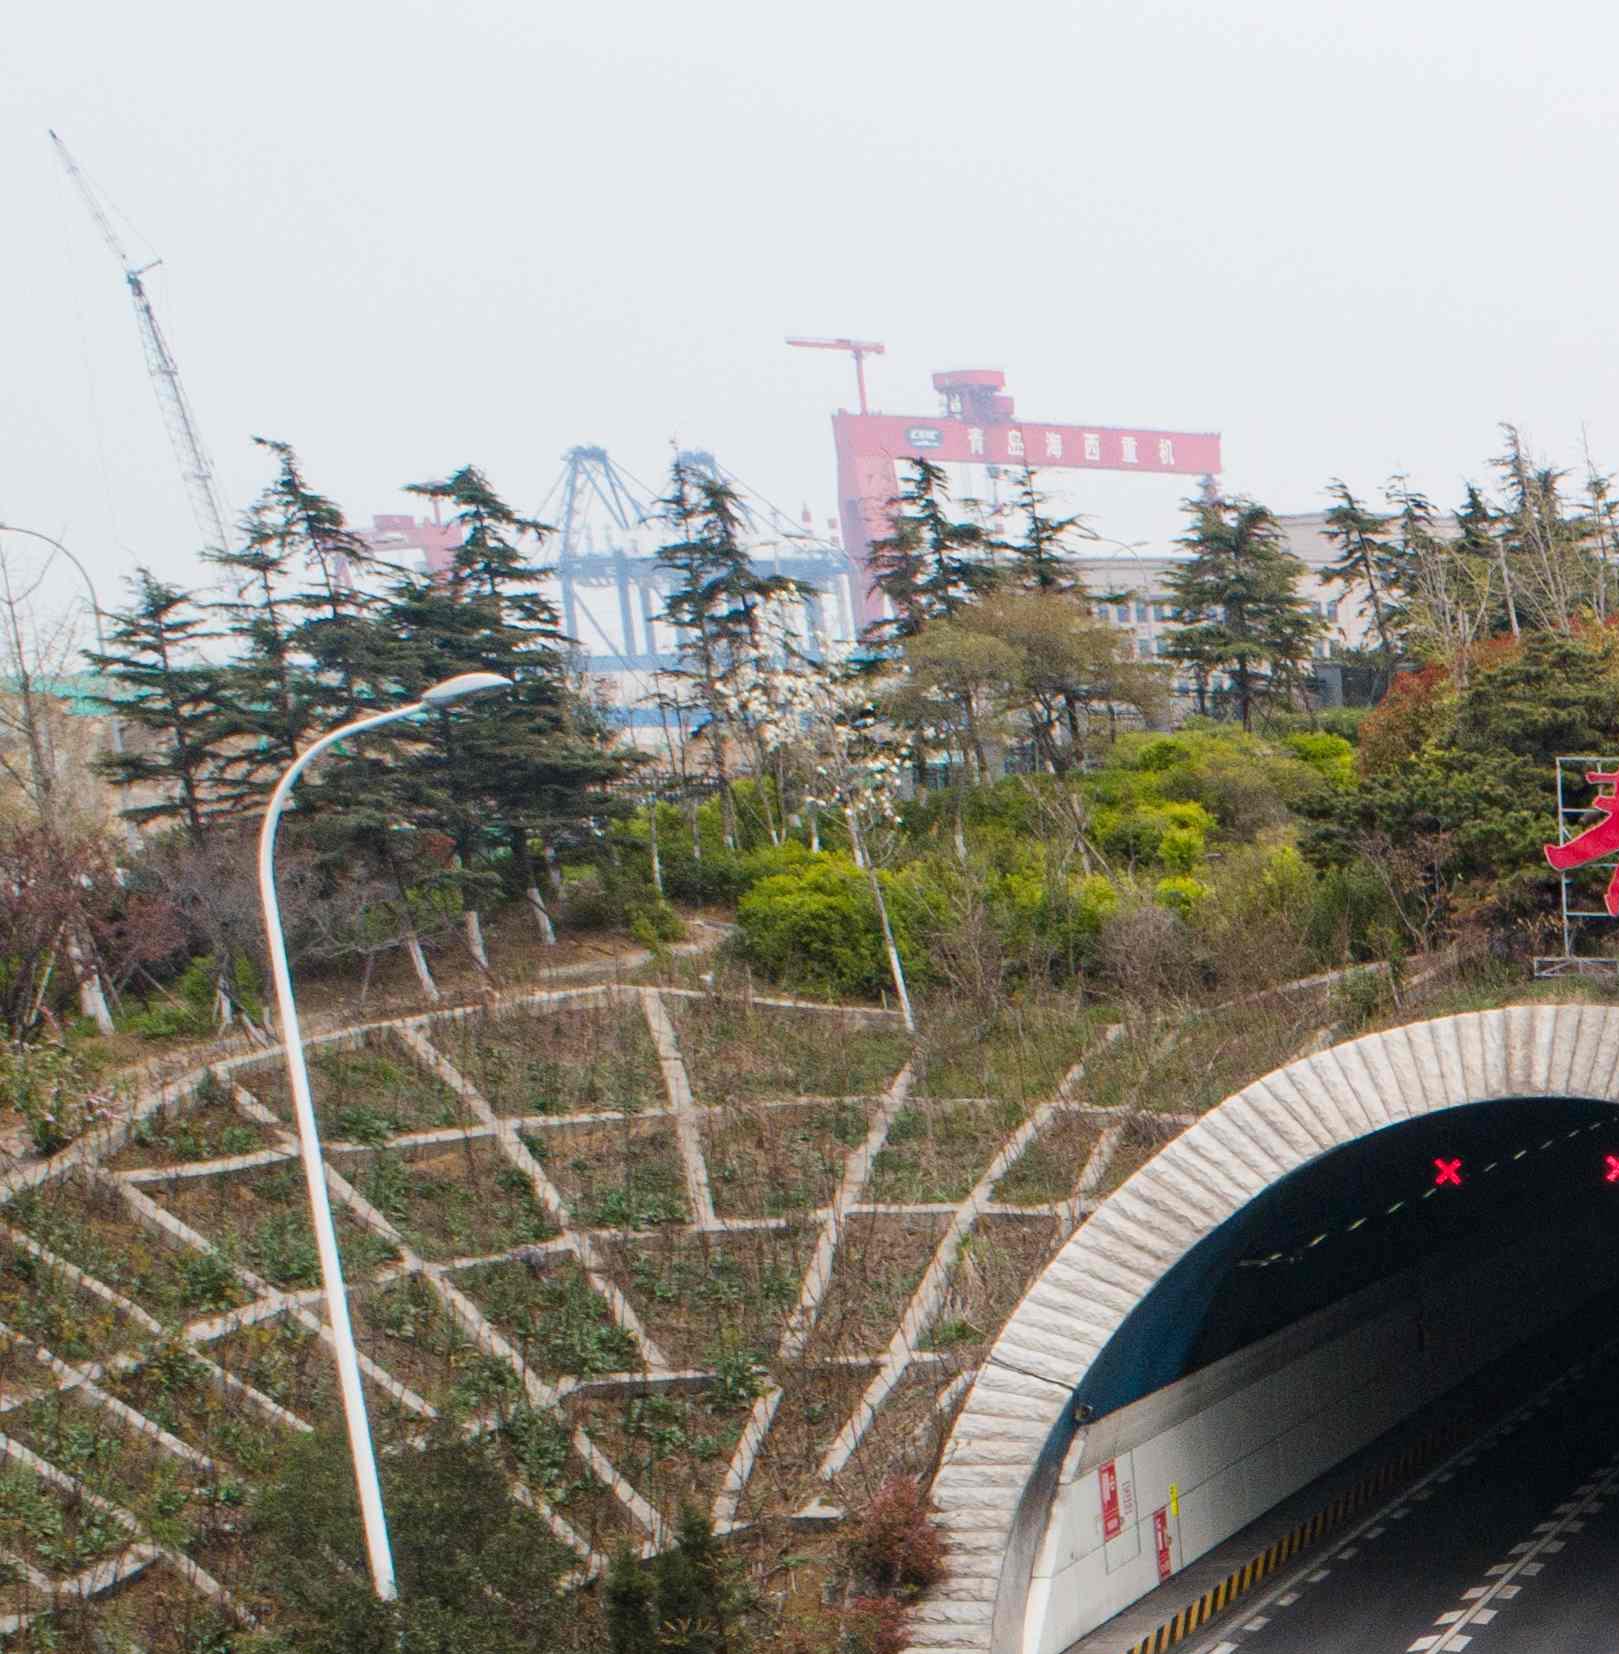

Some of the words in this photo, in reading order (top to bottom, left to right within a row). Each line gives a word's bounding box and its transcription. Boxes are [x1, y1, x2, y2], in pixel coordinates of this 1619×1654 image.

[968, 428, 1175, 465] 青岛海西重机
